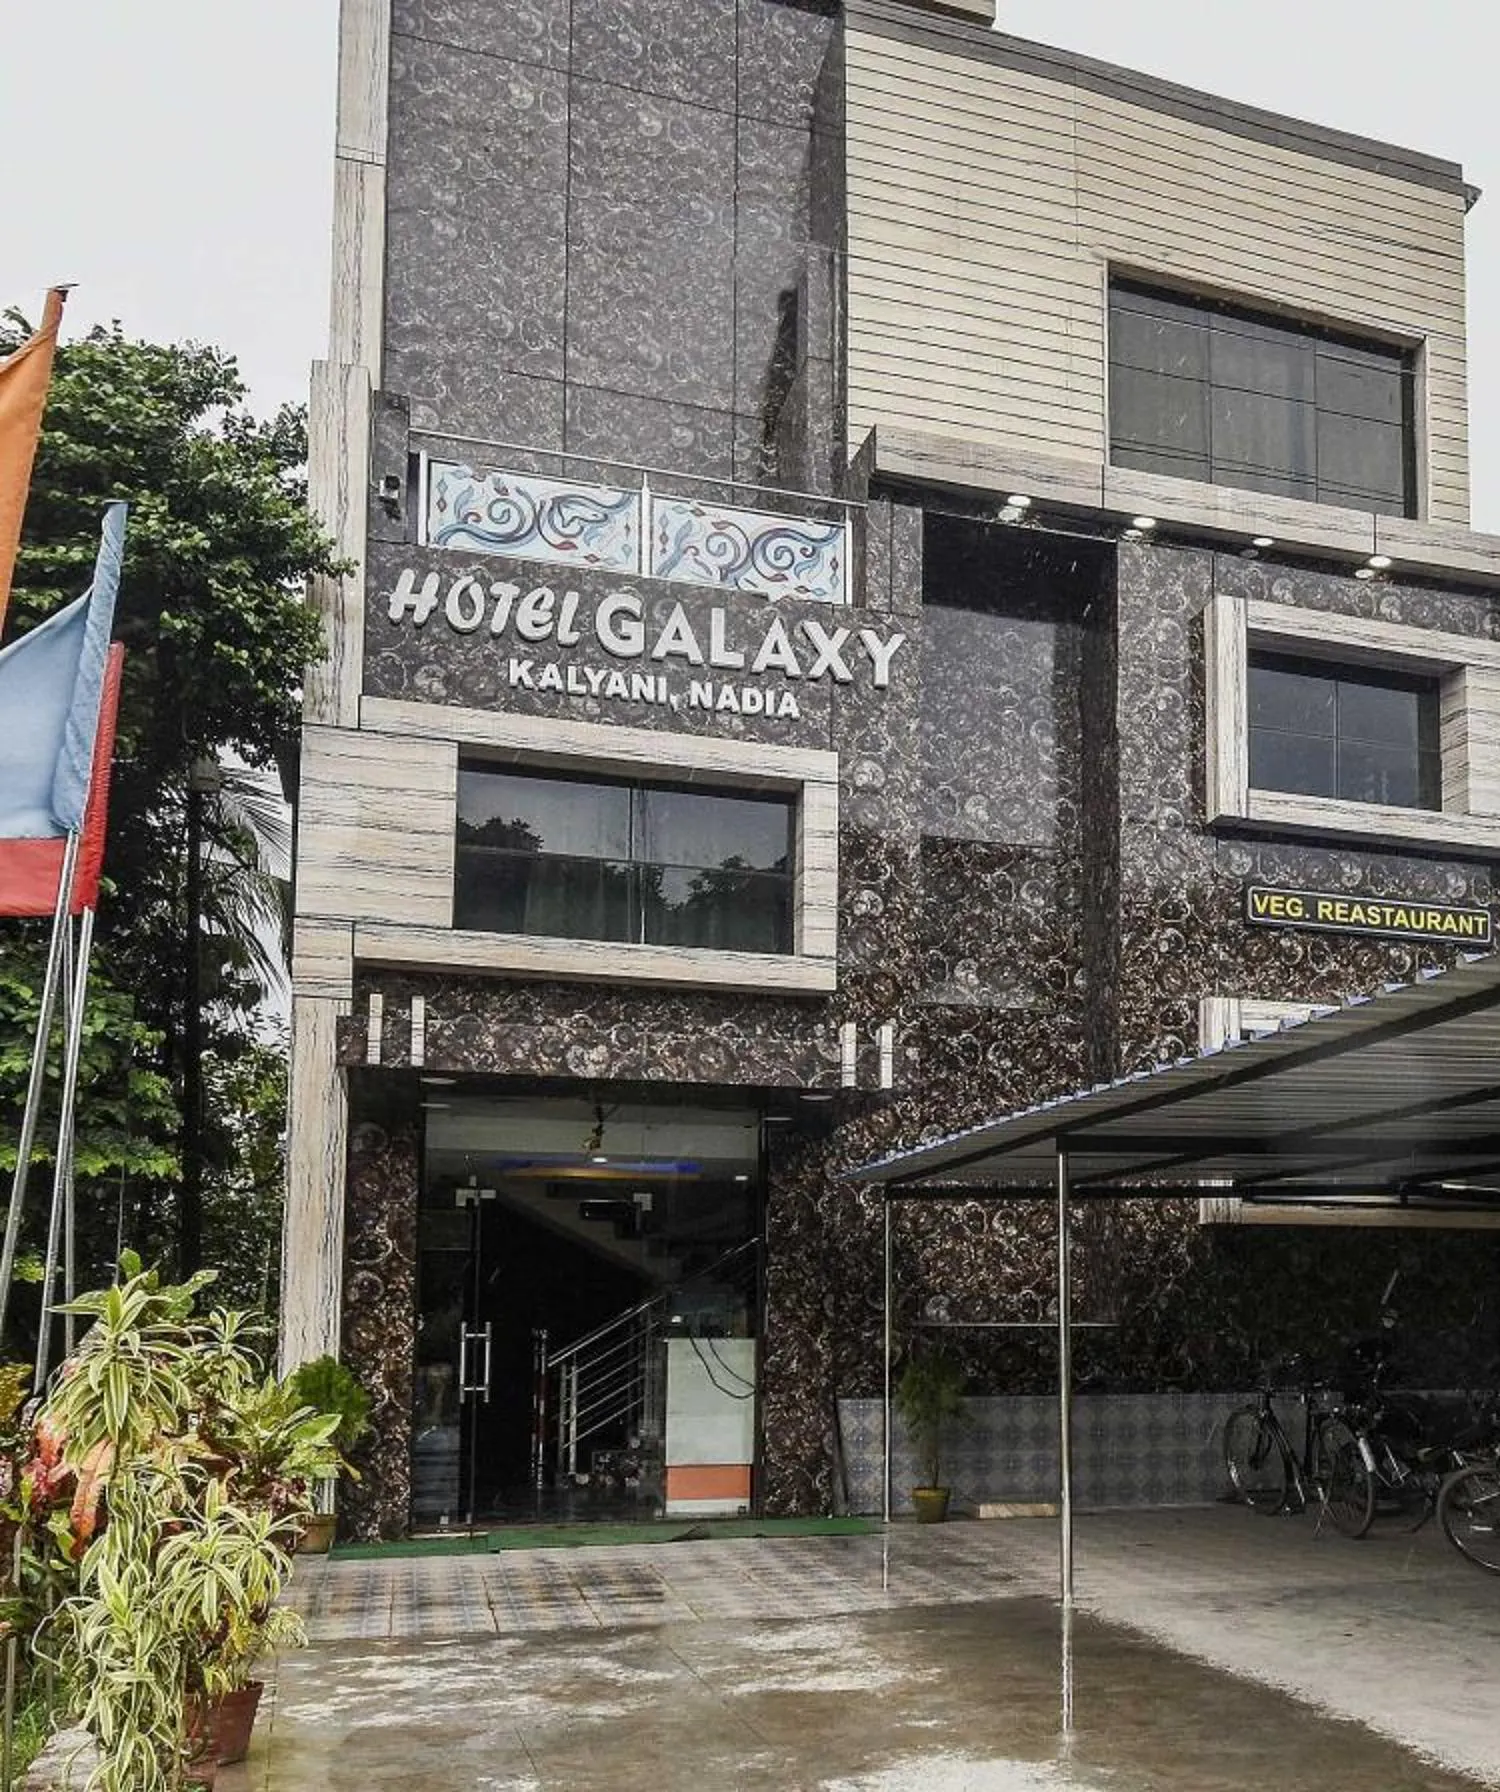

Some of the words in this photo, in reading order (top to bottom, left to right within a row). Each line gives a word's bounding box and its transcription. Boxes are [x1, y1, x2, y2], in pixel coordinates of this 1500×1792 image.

[595, 592, 907, 690] GALAXY
[508, 657, 679, 712] KALYANI,
[689, 680, 801, 720] NADIA
[1253, 894, 1311, 920] VEG.
[1317, 900, 1487, 936] REASTAURANT
